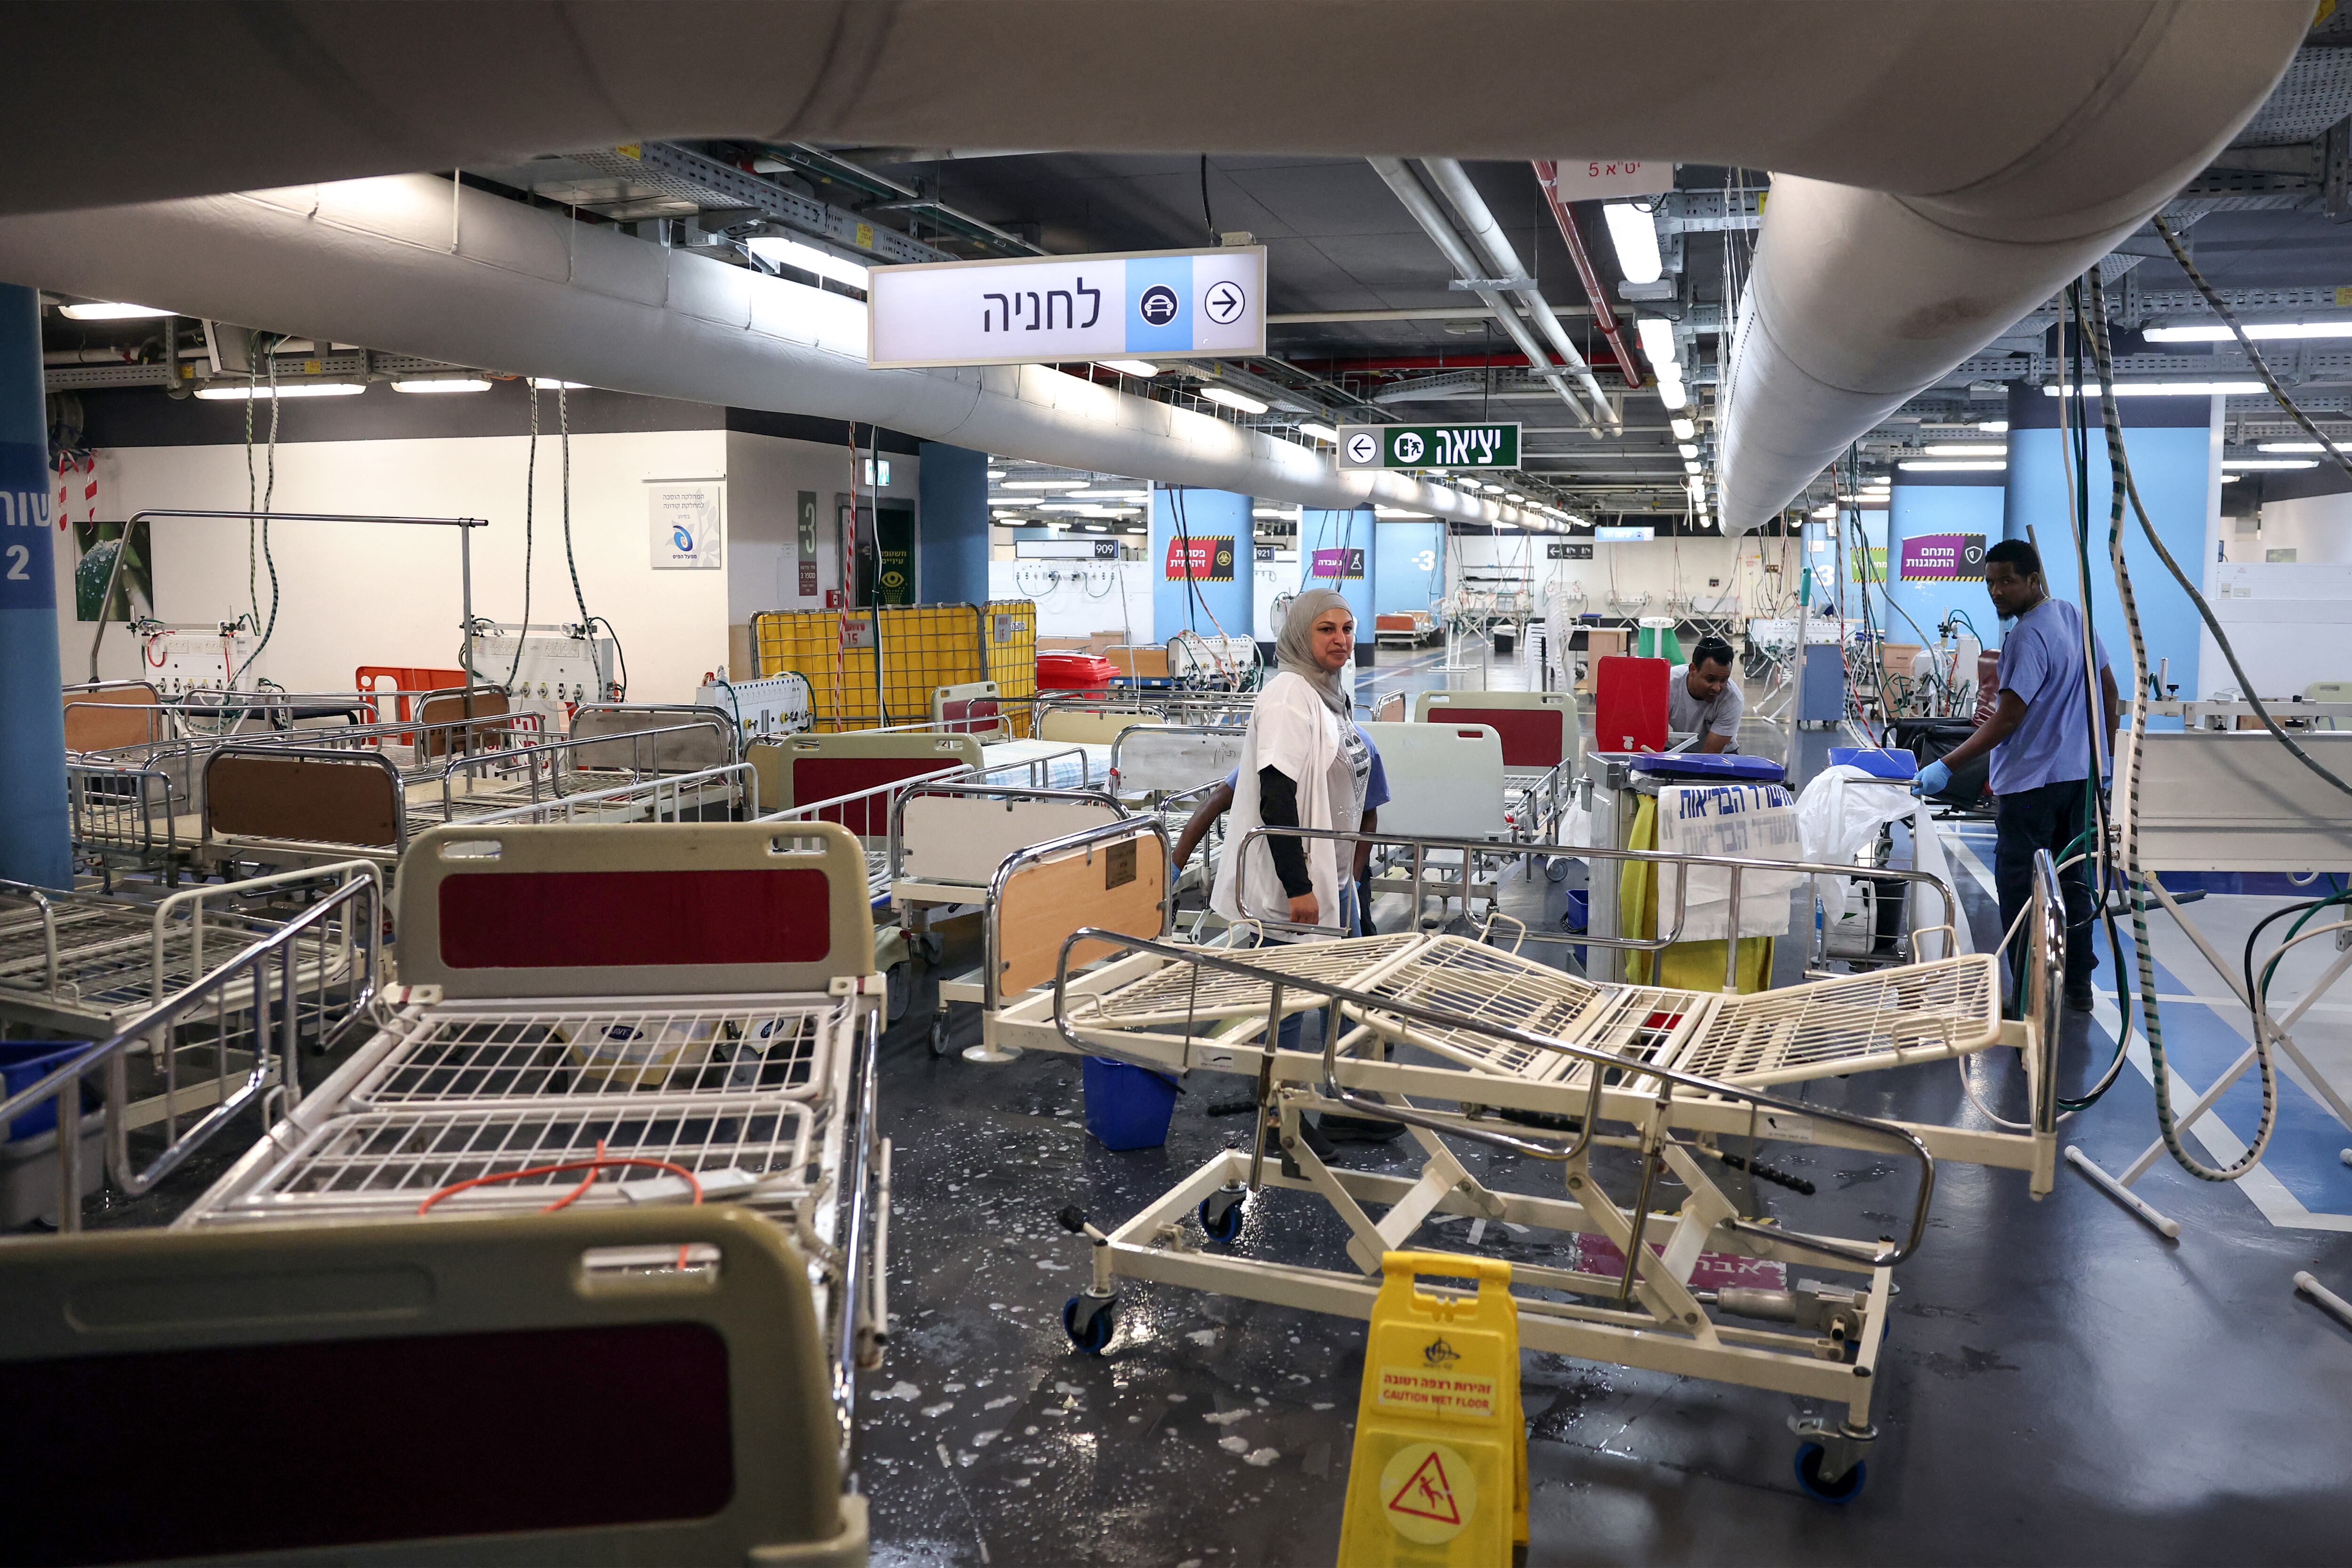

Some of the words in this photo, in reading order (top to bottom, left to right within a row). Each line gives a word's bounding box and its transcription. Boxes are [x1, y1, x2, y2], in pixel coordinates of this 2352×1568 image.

[1589, 162, 1599, 177] 5
[983, 277, 1101, 332] לחניה
[1436, 429, 1501, 464] יציאה
[0, 491, 51, 526] שור
[1096, 544, 1113, 554] 909
[1921, 543, 1955, 556] מתחם
[6, 545, 30, 580] 2
[1411, 550, 1435, 571] -3
[1906, 558, 1954, 567] התמגנות
[1811, 565, 1835, 587] -3
[846, 633, 858, 645] 15
[1680, 785, 1745, 819] הבריאות
[1748, 784, 1793, 810] משרד
[1383, 1374, 1418, 1387] רטובה
[1421, 1378, 1451, 1390] רצפה
[1454, 1381, 1493, 1395] זהירות
[1383, 1389, 1429, 1403] CAUTION
[1431, 1395, 1453, 1406] WET
[1456, 1397, 1489, 1409] FLOOR
